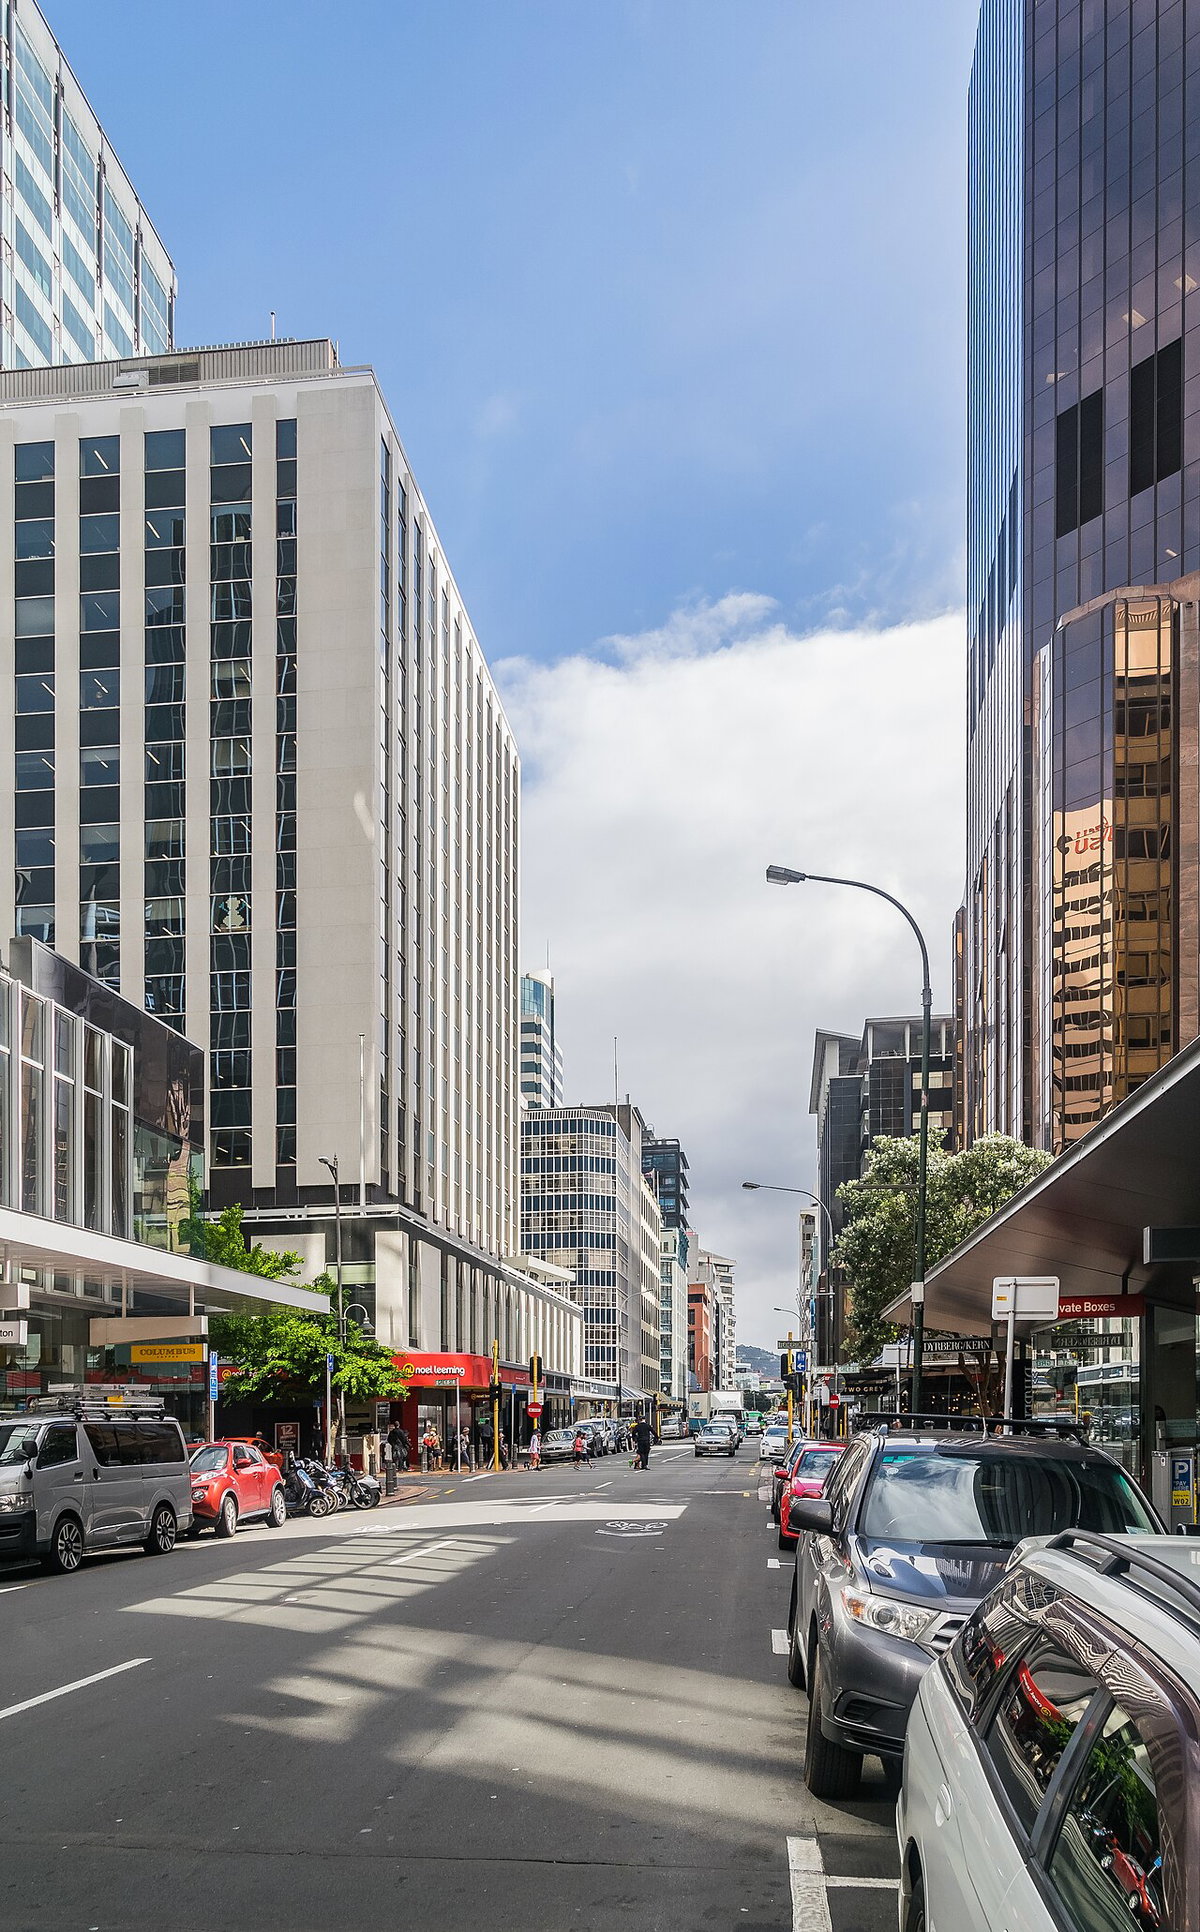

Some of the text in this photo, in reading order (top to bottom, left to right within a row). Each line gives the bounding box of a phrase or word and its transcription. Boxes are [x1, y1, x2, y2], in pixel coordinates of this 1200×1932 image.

[1083, 1302, 1116, 1312] Boxes
[140, 1348, 196, 1356] COLUMBUS
[415, 1365, 432, 1375] noel
[433, 1365, 465, 1376] leeming
[280, 1425, 293, 1435] 12
[1175, 1462, 1189, 1479] P
